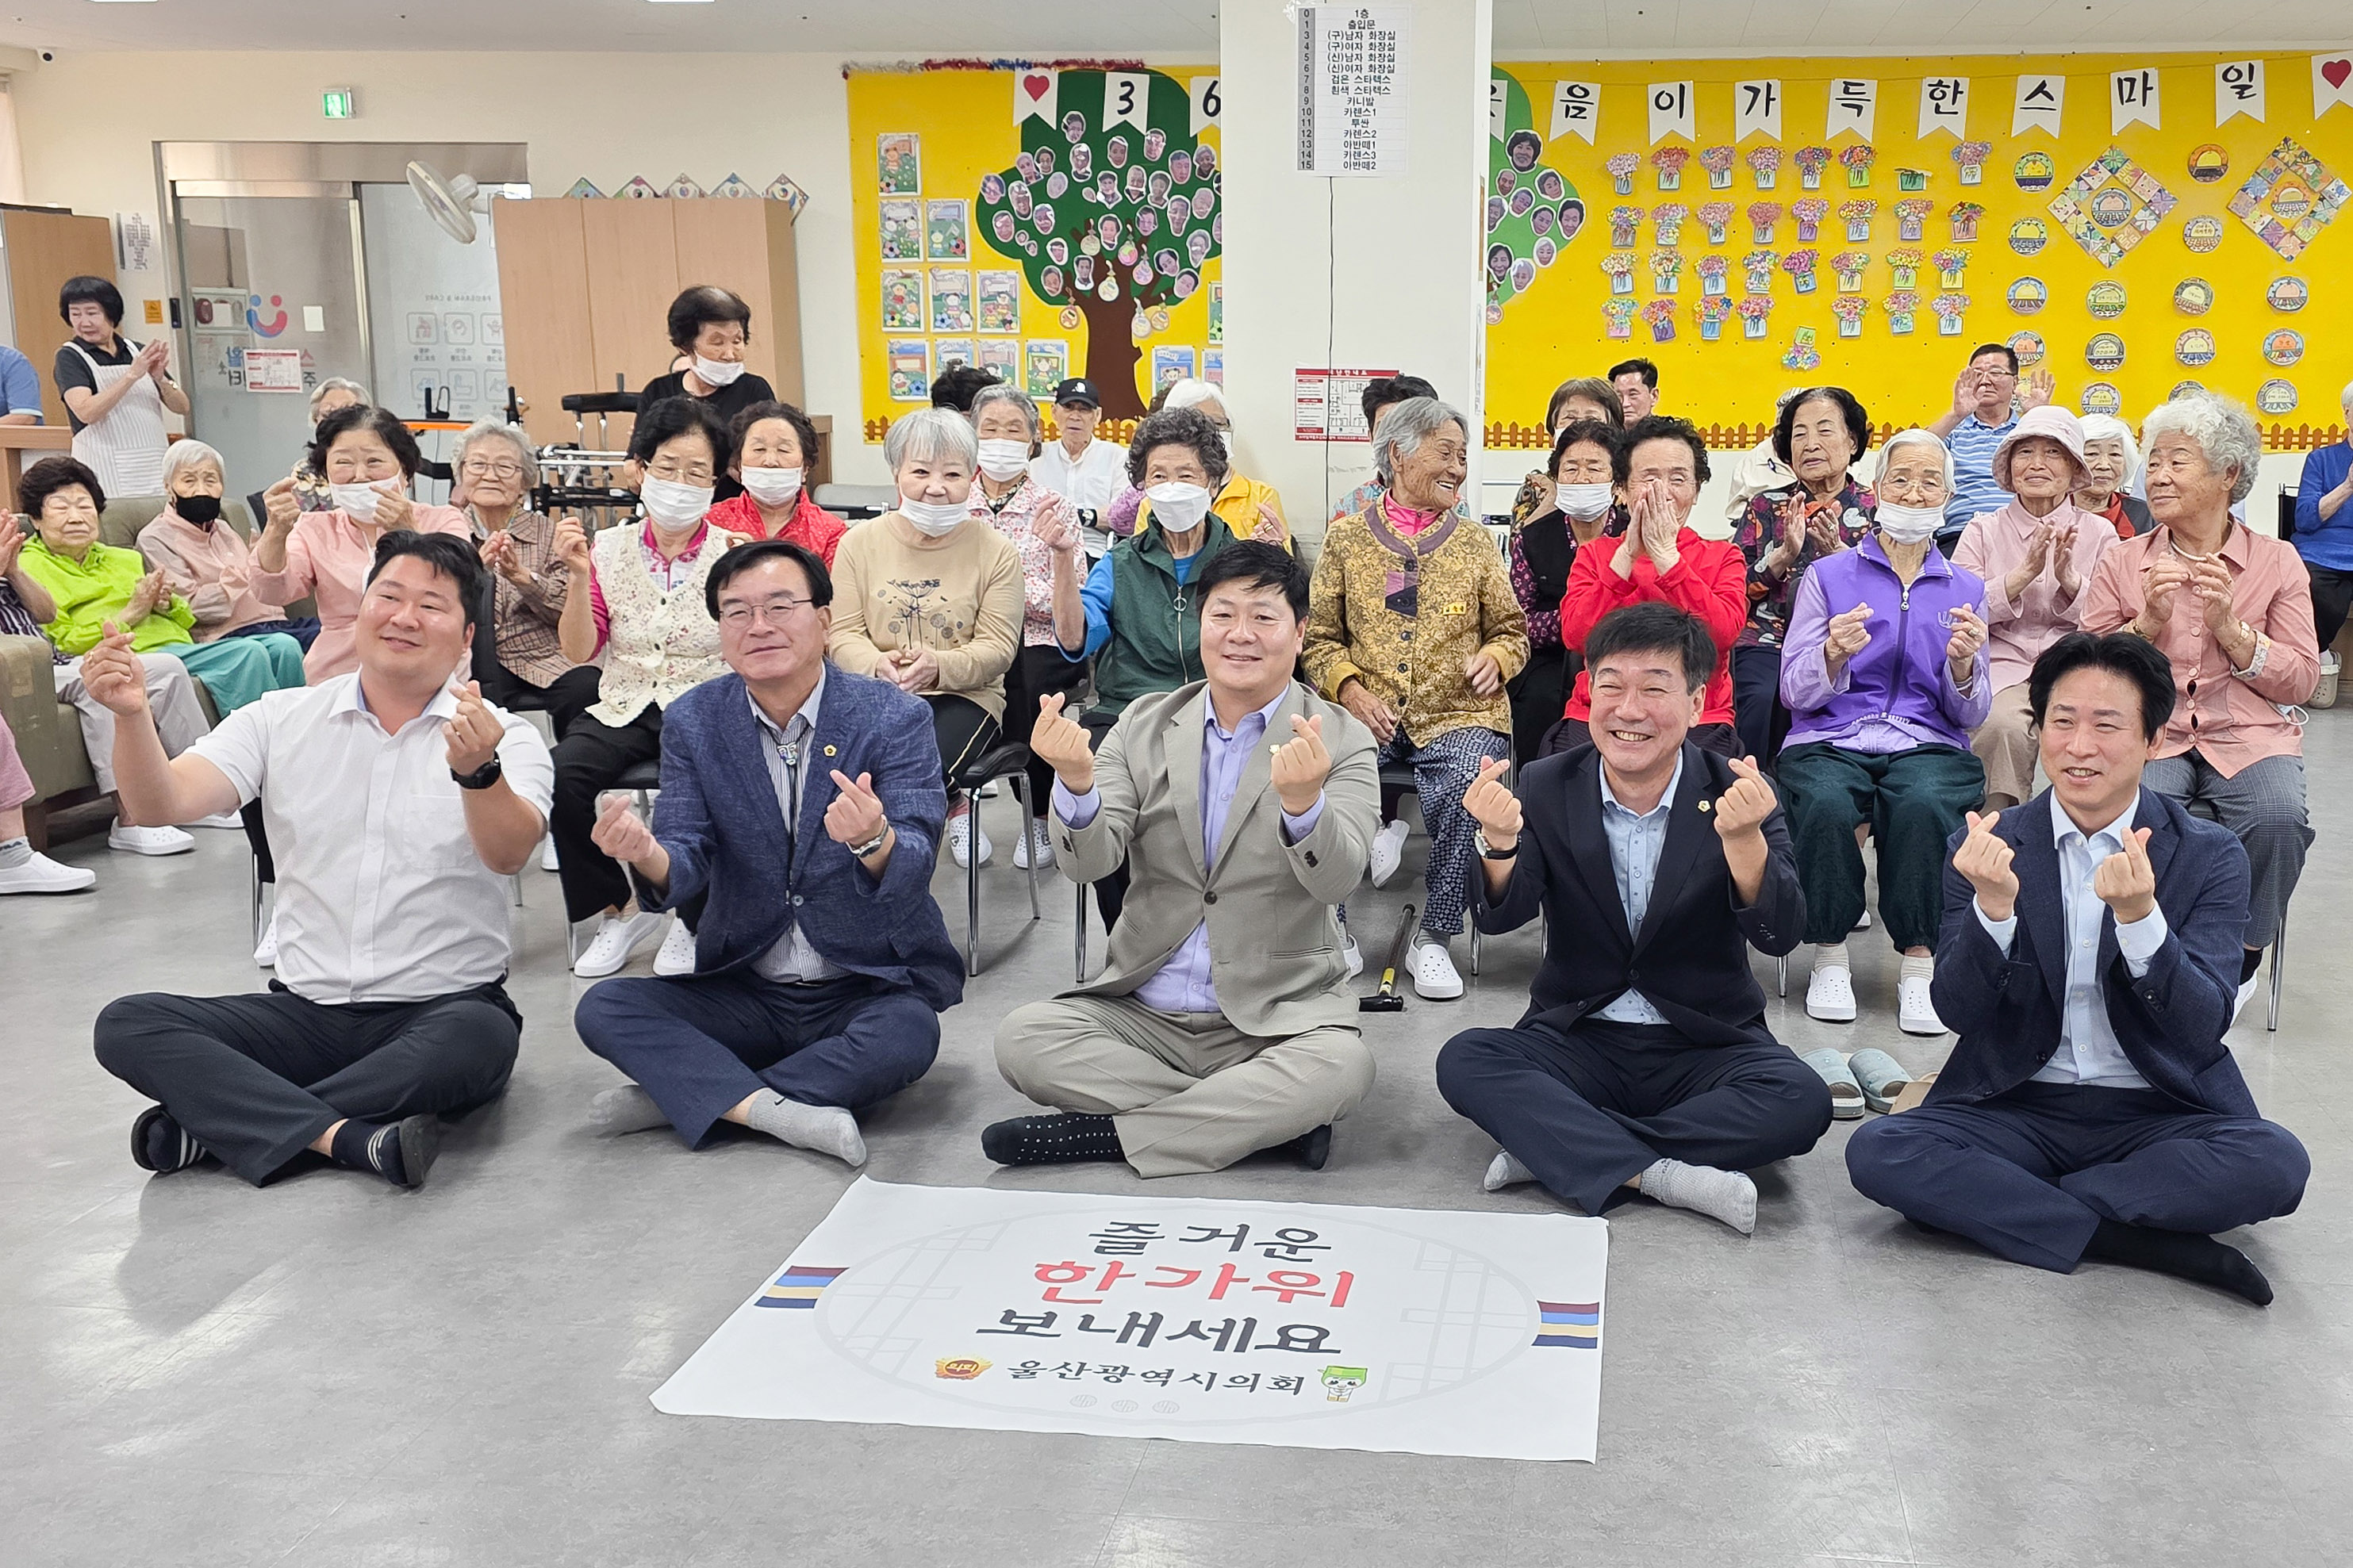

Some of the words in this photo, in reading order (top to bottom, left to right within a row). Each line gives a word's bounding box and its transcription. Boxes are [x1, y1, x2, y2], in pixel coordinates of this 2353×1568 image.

[1303, 9, 1310, 17] 0
[1355, 8, 1369, 19] 1층
[1304, 20, 1309, 29] 1
[1348, 19, 1376, 30] 출입문
[1304, 31, 1310, 40] 3
[1327, 30, 1364, 41] (구)남자
[1368, 30, 1395, 41] 화장실
[1368, 41, 1395, 52] 화장실
[1304, 52, 1309, 62] 5
[1327, 52, 1363, 63] (신)남자
[1368, 52, 1395, 63] 화장실
[1304, 63, 1309, 72] 6
[1368, 63, 1395, 74] 화장실
[1303, 75, 1310, 83] 7
[1331, 74, 1349, 85] 검은
[1353, 75, 1391, 85] 스타렉스
[1303, 86, 1309, 94] 8
[1331, 85, 1349, 96] 흰색
[1353, 86, 1391, 96] 스타렉스
[1303, 97, 1309, 105] 9
[1302, 107, 1312, 116] 10
[1344, 107, 1376, 117] 카렌스1
[1351, 118, 1369, 128] 투싼
[1302, 128, 1311, 138] 12
[1344, 128, 1377, 139] 카렌스2
[1302, 140, 1312, 148] 13
[1343, 140, 1376, 150] 아반떼1
[1343, 150, 1376, 160] 카렌스3
[1301, 160, 1311, 169] 15
[1343, 160, 1376, 171] 아반떼2
[1088, 1221, 1332, 1263] 즐거운
[1034, 1260, 1354, 1308] 한가위
[975, 1309, 1342, 1354] 보내세요
[1007, 1359, 1305, 1396] 울산광역시의회
